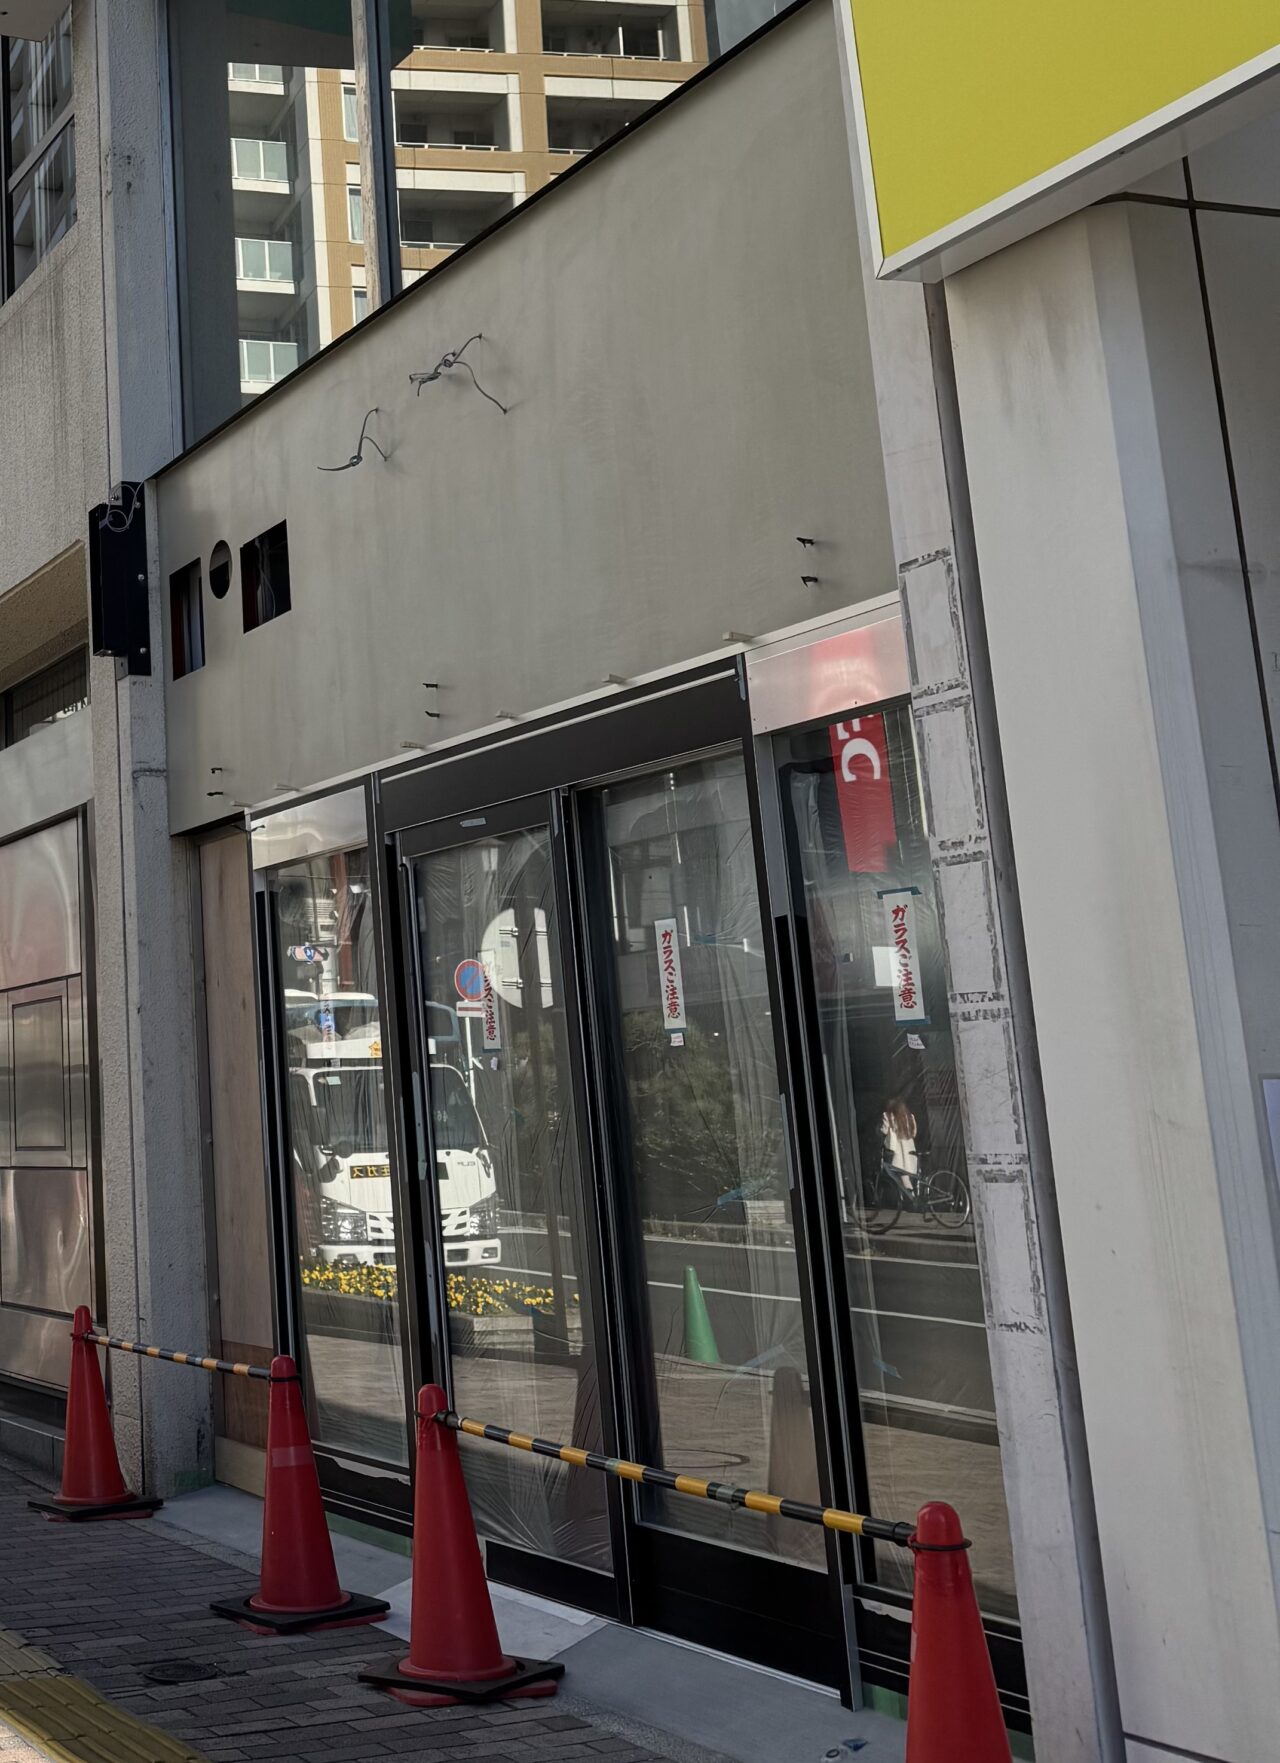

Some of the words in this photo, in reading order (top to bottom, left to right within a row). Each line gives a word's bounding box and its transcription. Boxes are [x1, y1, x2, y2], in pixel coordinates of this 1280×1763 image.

[661, 929, 680, 1018] ガラスご注意
[891, 904, 918, 1009] ガラスご注意
